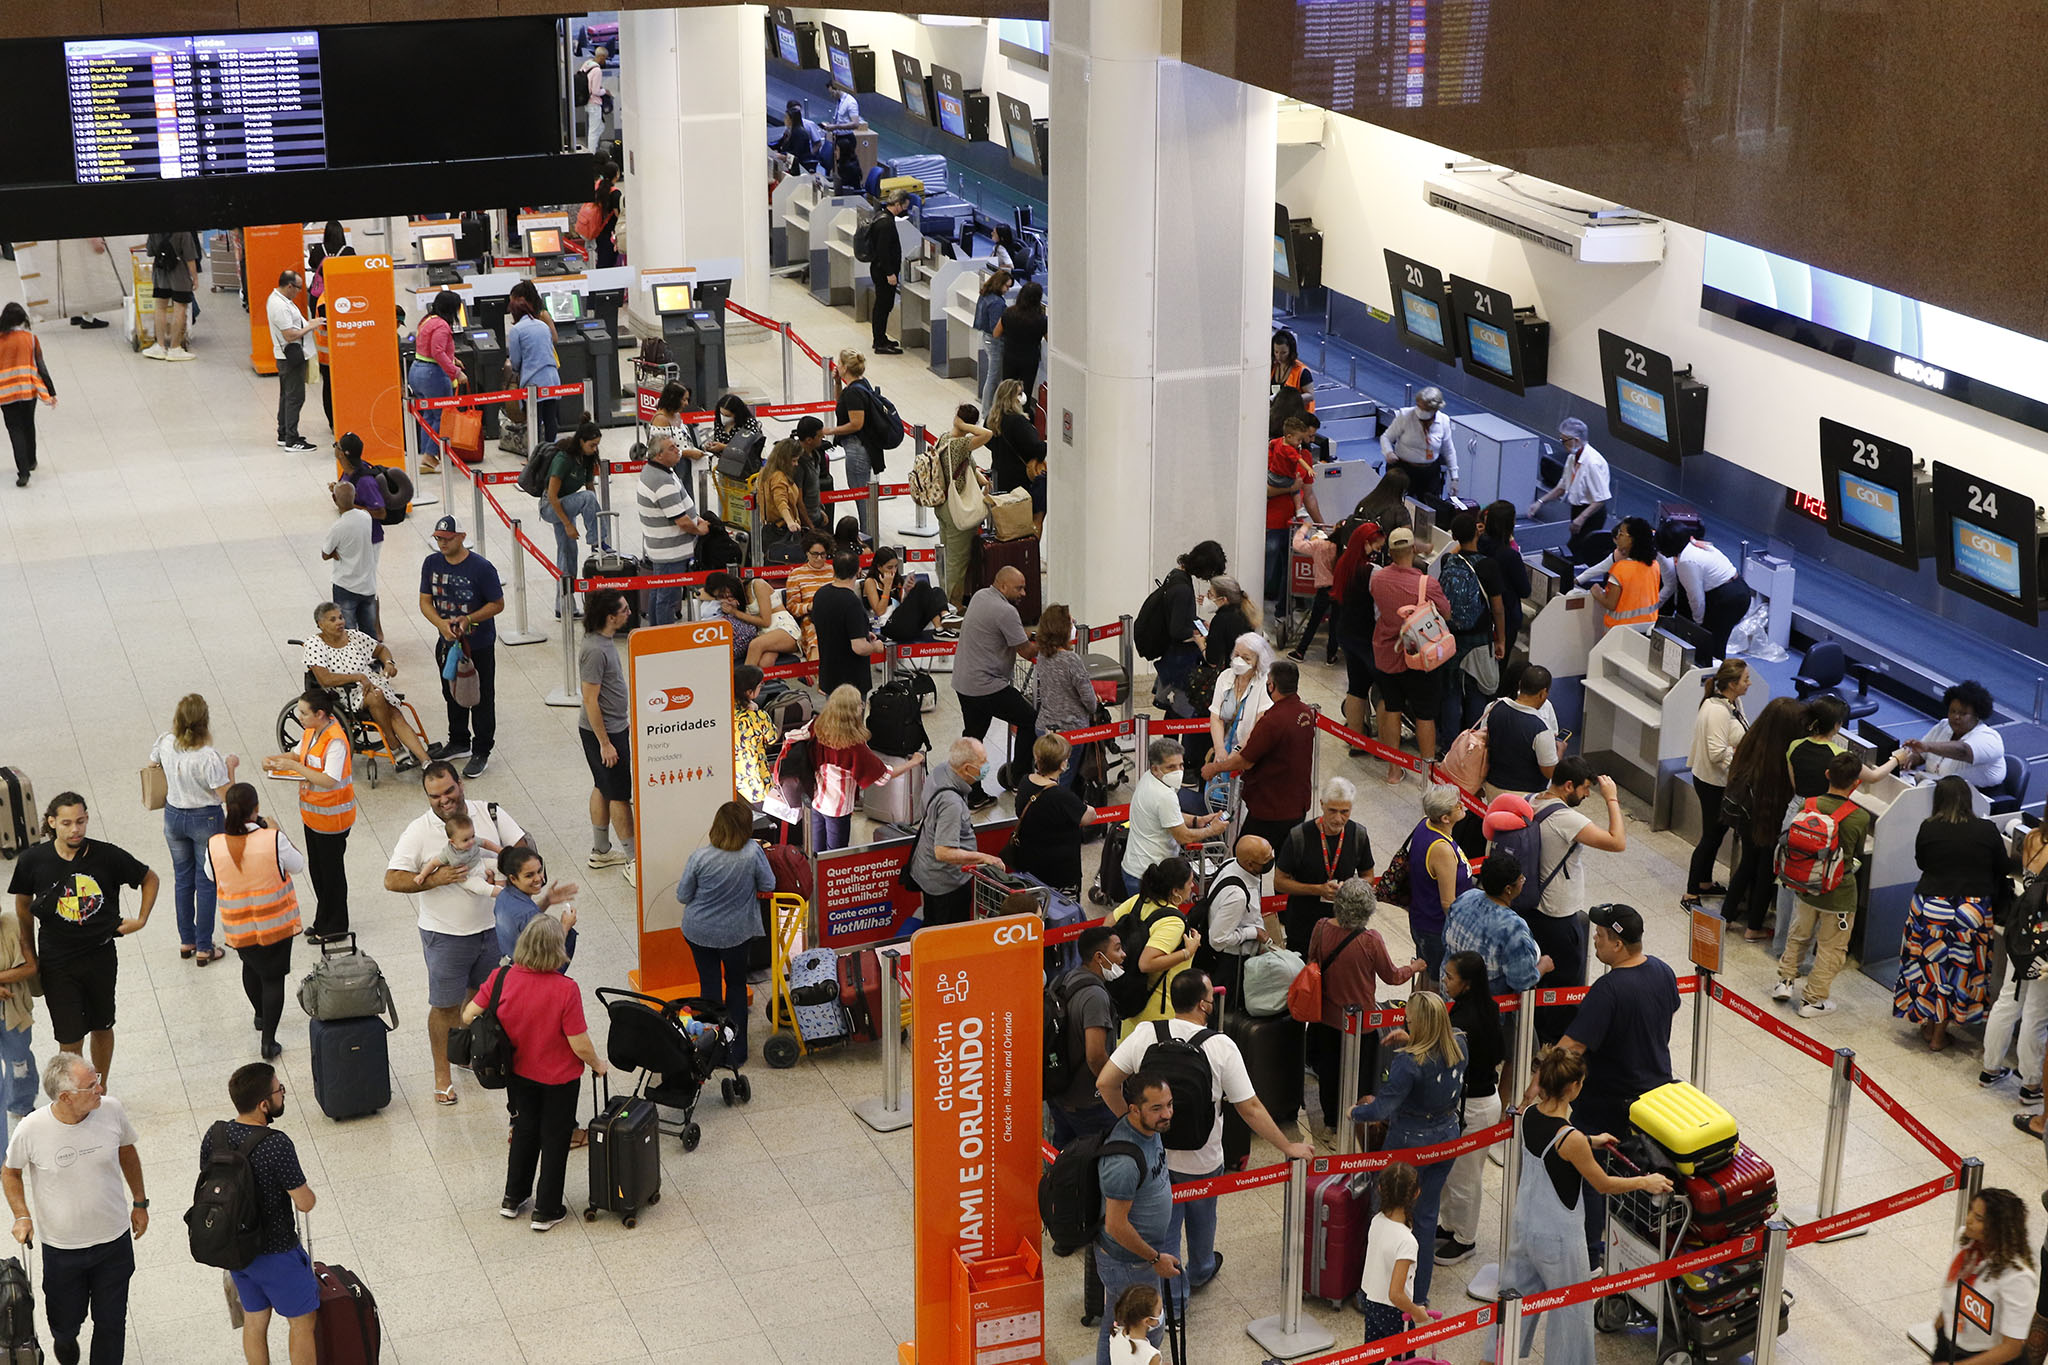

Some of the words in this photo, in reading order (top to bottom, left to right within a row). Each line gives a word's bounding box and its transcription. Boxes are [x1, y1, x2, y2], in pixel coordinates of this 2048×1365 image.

[832, 30, 840, 46] 13
[903, 59, 913, 75] 14
[942, 73, 952, 90] 15
[1010, 103, 1021, 121] 16
[364, 258, 390, 269] GOL
[1405, 264, 1424, 288] 20
[1474, 291, 1493, 316] 21
[336, 320, 376, 329] Bagagem
[1480, 330, 1498, 346] GOL
[1624, 348, 1648, 377] 22
[1630, 391, 1652, 409] GOL
[1852, 439, 1880, 470] 23
[1857, 487, 1883, 508] GOL
[1968, 485, 1998, 519] 24
[1972, 536, 2001, 558] GOL
[596, 581, 629, 589] HotMilhas
[692, 626, 729, 643] GOL
[920, 647, 954, 655] HotMilhas
[648, 697, 666, 706] GOL
[647, 719, 717, 736] Prioridades
[647, 742, 670, 752] Priority
[648, 753, 682, 763] Prioridades
[827, 867, 852, 877] Quer
[853, 858, 899, 874] aprender
[827, 888, 840, 897] de
[842, 881, 876, 894] utilizar
[878, 880, 889, 888] as
[836, 873, 870, 886] melhor
[827, 896, 850, 907] suas
[851, 888, 889, 903] milhas?
[829, 910, 857, 921] Conte
[858, 906, 877, 915] com
[832, 916, 892, 935] HotMilhas
[993, 922, 1039, 946] GOL
[1003, 1011, 1013, 1049] Orlando
[1729, 998, 1760, 1021] HotMilhas
[1777, 1025, 1793, 1040] Venda
[1793, 1034, 1805, 1046] suas
[1805, 1039, 1822, 1056] milhas
[934, 1021, 953, 1111] check-in
[1003, 1050, 1013, 1068] and
[959, 1017, 984, 1159] ORLANDO
[1003, 1070, 1013, 1097] Miami
[1003, 1104, 1013, 1142] Check-in
[1866, 1083, 1891, 1110] HotMilhas
[1904, 1117, 1918, 1133] Venda
[1926, 1136, 1941, 1153] milhas
[1340, 1158, 1388, 1170] HotMilhas
[1416, 1151, 1439, 1160] Venda
[1440, 1148, 1456, 1156] suas
[1456, 1140, 1477, 1151] milhas
[959, 1163, 984, 1183] E
[1235, 1176, 1259, 1187] Venda
[1260, 1172, 1277, 1182] suas
[1815, 1222, 1834, 1235] Venda
[1835, 1218, 1849, 1230] suas
[1849, 1211, 1871, 1226] milhas
[1887, 1186, 1936, 1209] hotmilhas.com.br
[1521, 1296, 1566, 1312] HotMilhas
[1591, 1283, 1614, 1294] Venda
[1615, 1279, 1632, 1289] suas
[1632, 1272, 1656, 1283] milhas
[1676, 1248, 1732, 1270] hotmilhas.com.br
[1964, 1294, 1988, 1324] GOL
[1341, 1354, 1359, 1365] suas
[1360, 1347, 1385, 1360] milhas
[1407, 1320, 1466, 1345] hotmilhas.com.br
